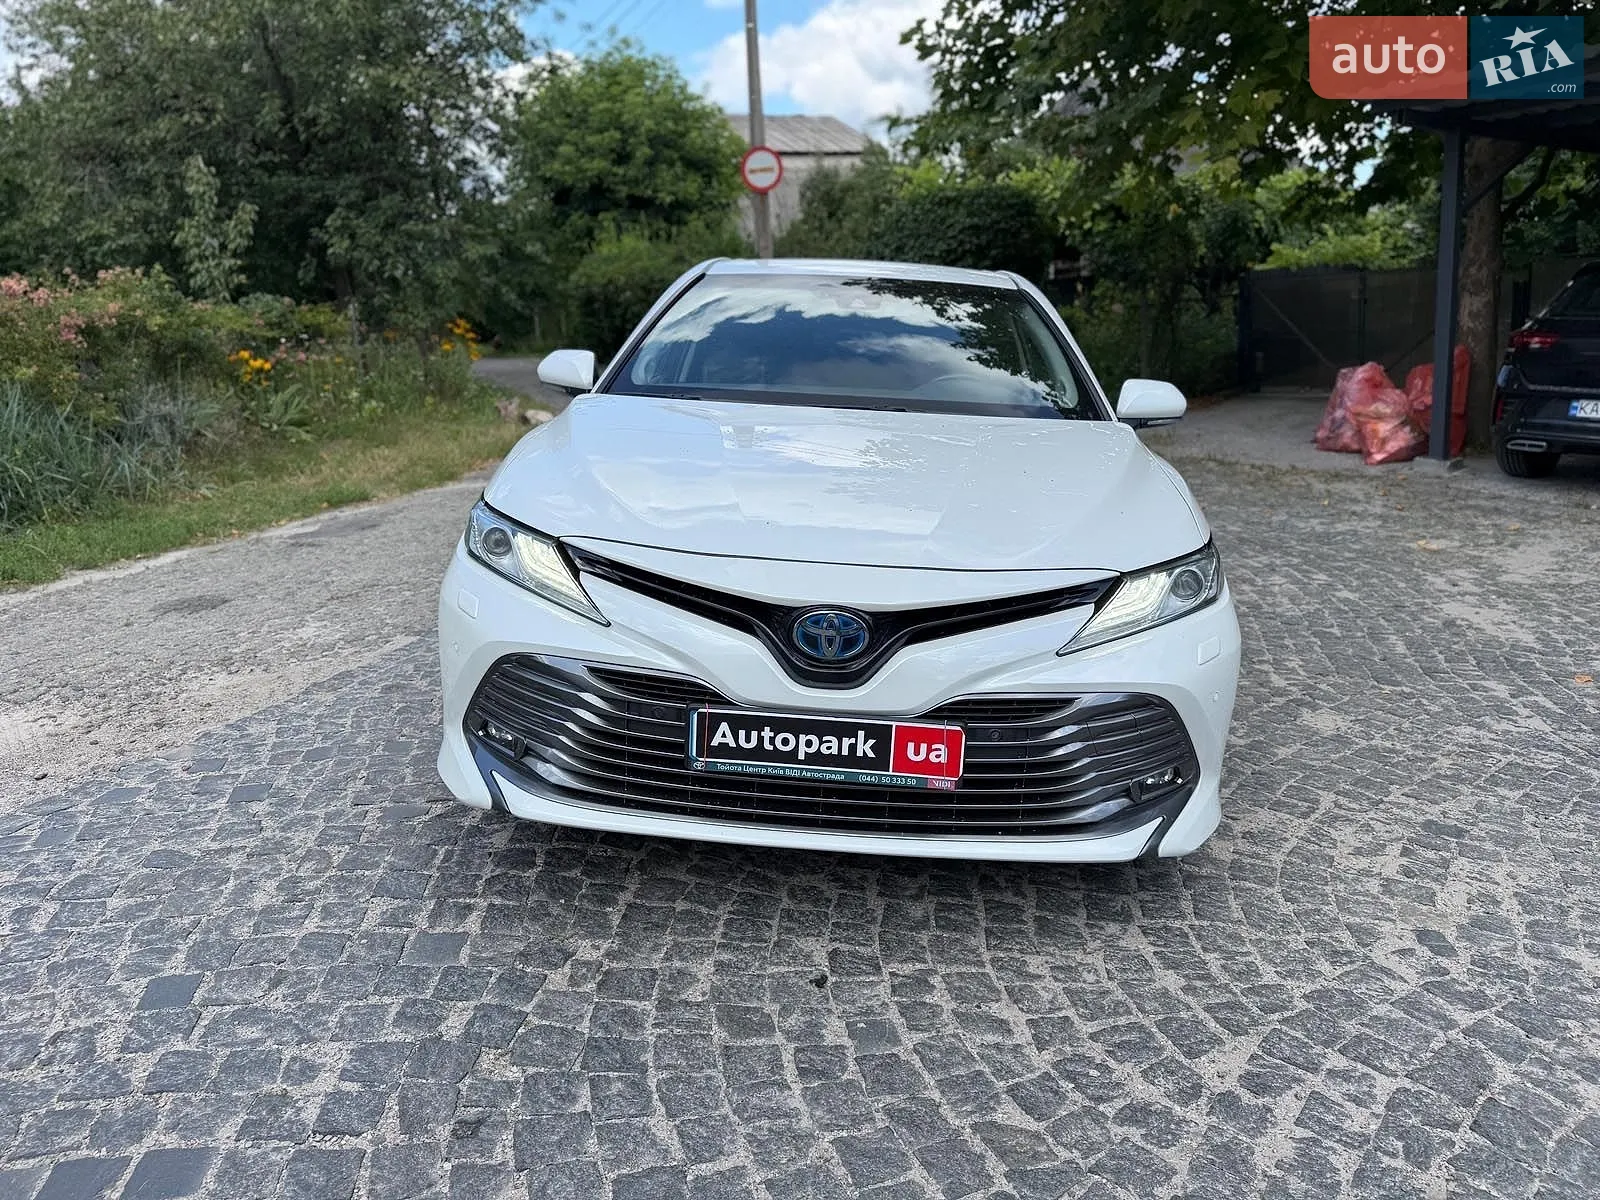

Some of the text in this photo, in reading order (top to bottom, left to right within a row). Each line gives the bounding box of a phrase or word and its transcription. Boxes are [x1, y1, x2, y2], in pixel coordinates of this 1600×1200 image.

[710, 721, 948, 764] Autopark ua
[716, 763, 742, 771] Тойота
[743, 765, 767, 775] Центр
[767, 767, 784, 775] Київ
[801, 770, 845, 781] Автострада
[858, 774, 917, 786] (044) 50 333 50
